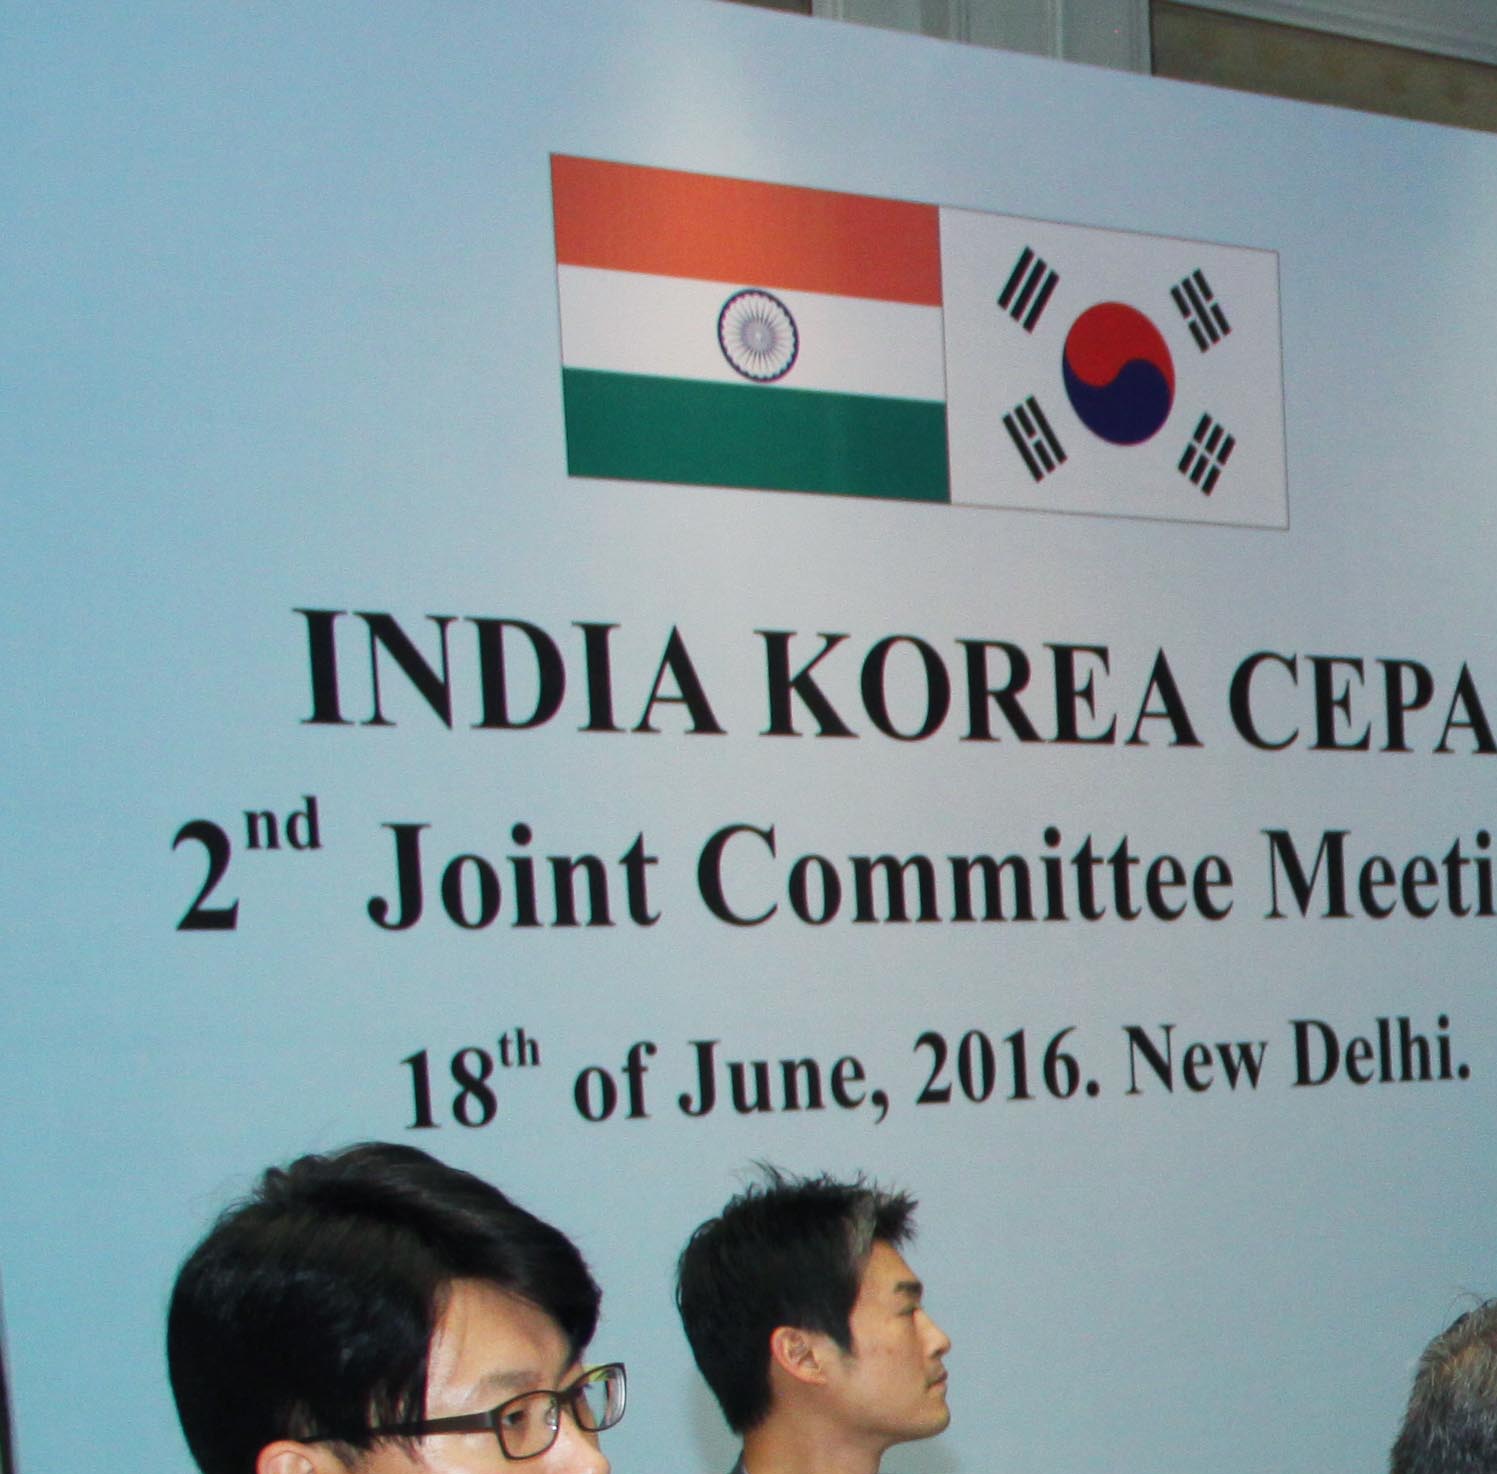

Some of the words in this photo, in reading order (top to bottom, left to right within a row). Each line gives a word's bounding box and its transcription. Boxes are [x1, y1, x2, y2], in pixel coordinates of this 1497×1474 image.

[296, 609, 724, 735] INDIA
[761, 631, 1202, 747] KOREA
[172, 796, 321, 931] 2nd
[367, 823, 659, 931] Joint
[697, 824, 1233, 926] Committee
[403, 1028, 539, 1129] 18th
[574, 1042, 656, 1122] of
[678, 1041, 889, 1124] June,
[915, 1028, 1100, 1105] 2016.
[1125, 1025, 1264, 1095] New
[1293, 1014, 1473, 1087] Delhi.
